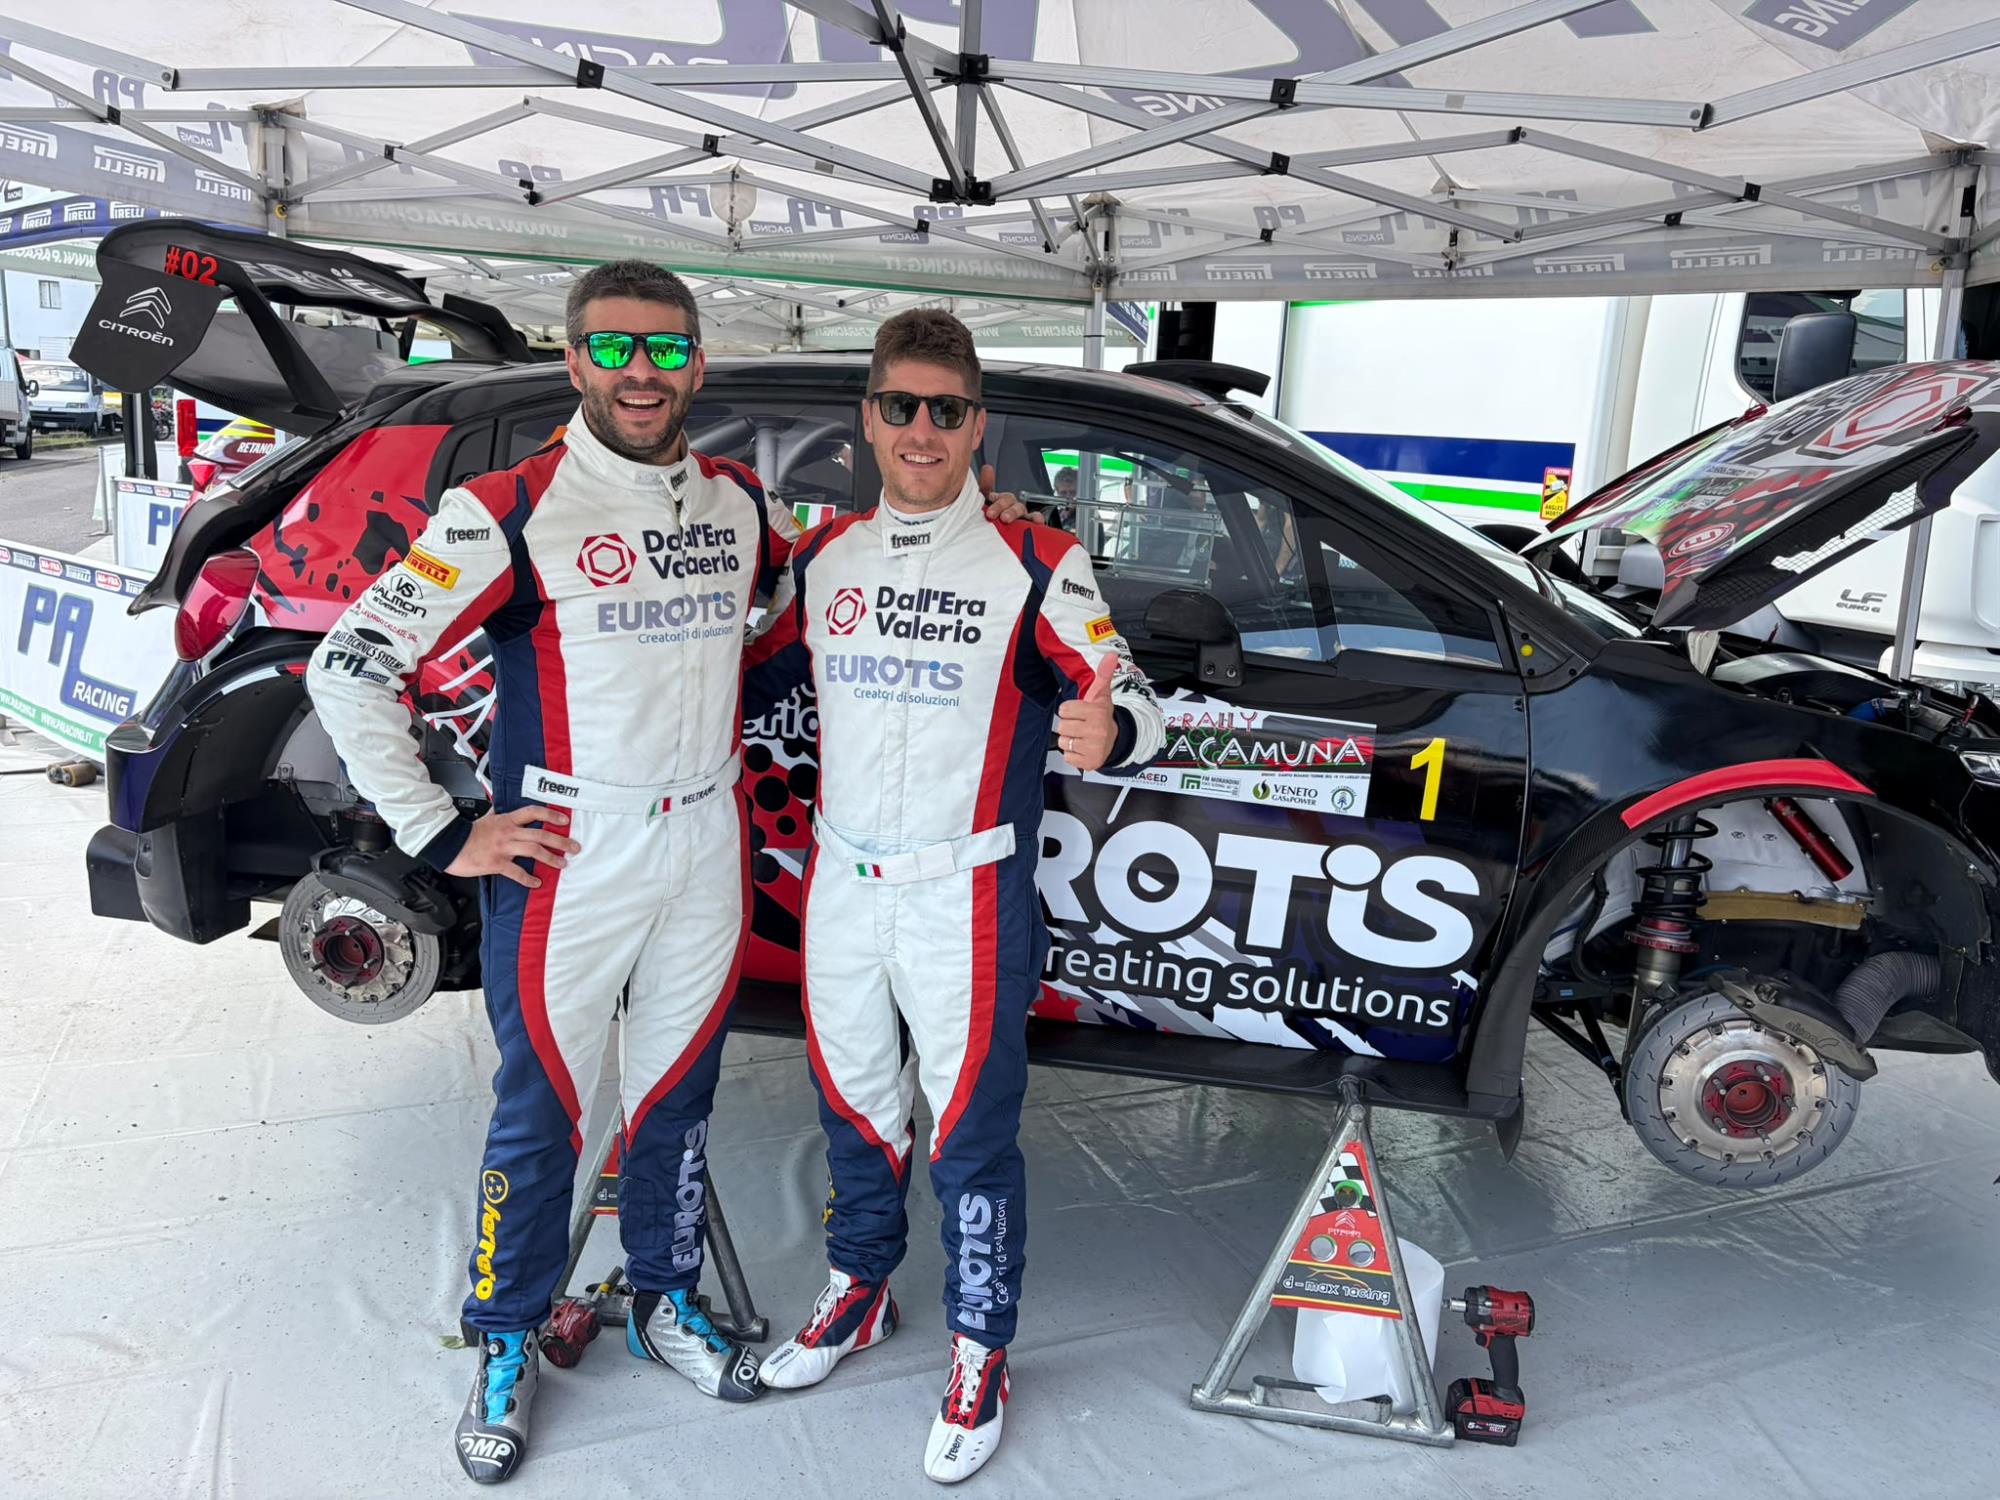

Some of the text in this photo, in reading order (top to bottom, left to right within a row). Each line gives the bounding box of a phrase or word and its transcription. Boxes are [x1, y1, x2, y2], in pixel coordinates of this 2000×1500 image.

[22, 209, 52, 230] PIRELLI
[64, 202, 96, 222] PIRELLI
[110, 201, 145, 219] PIRELLI
[165, 248, 218, 286] #02
[446, 527, 491, 544] freem
[891, 532, 931, 549] freem
[397, 577, 416, 599] VS
[1062, 578, 1095, 601] freem
[1840, 589, 1887, 604] LF
[876, 586, 986, 617] Dall'Era
[876, 613, 982, 644] Valerio
[1093, 620, 1115, 636] PIRE
[73, 681, 130, 717] RACING
[854, 686, 960, 708] Creatori di soluzioni
[1164, 735, 1366, 770] ACAMUNA
[538, 777, 580, 798] freem
[1410, 737, 1447, 822] 1
[1274, 783, 1318, 799] VENETO
[1033, 808, 1481, 969] ROTiS
[1045, 945, 1452, 1028] reating solutions
[461, 1435, 511, 1460] OMP
[945, 1434, 964, 1461] freem
